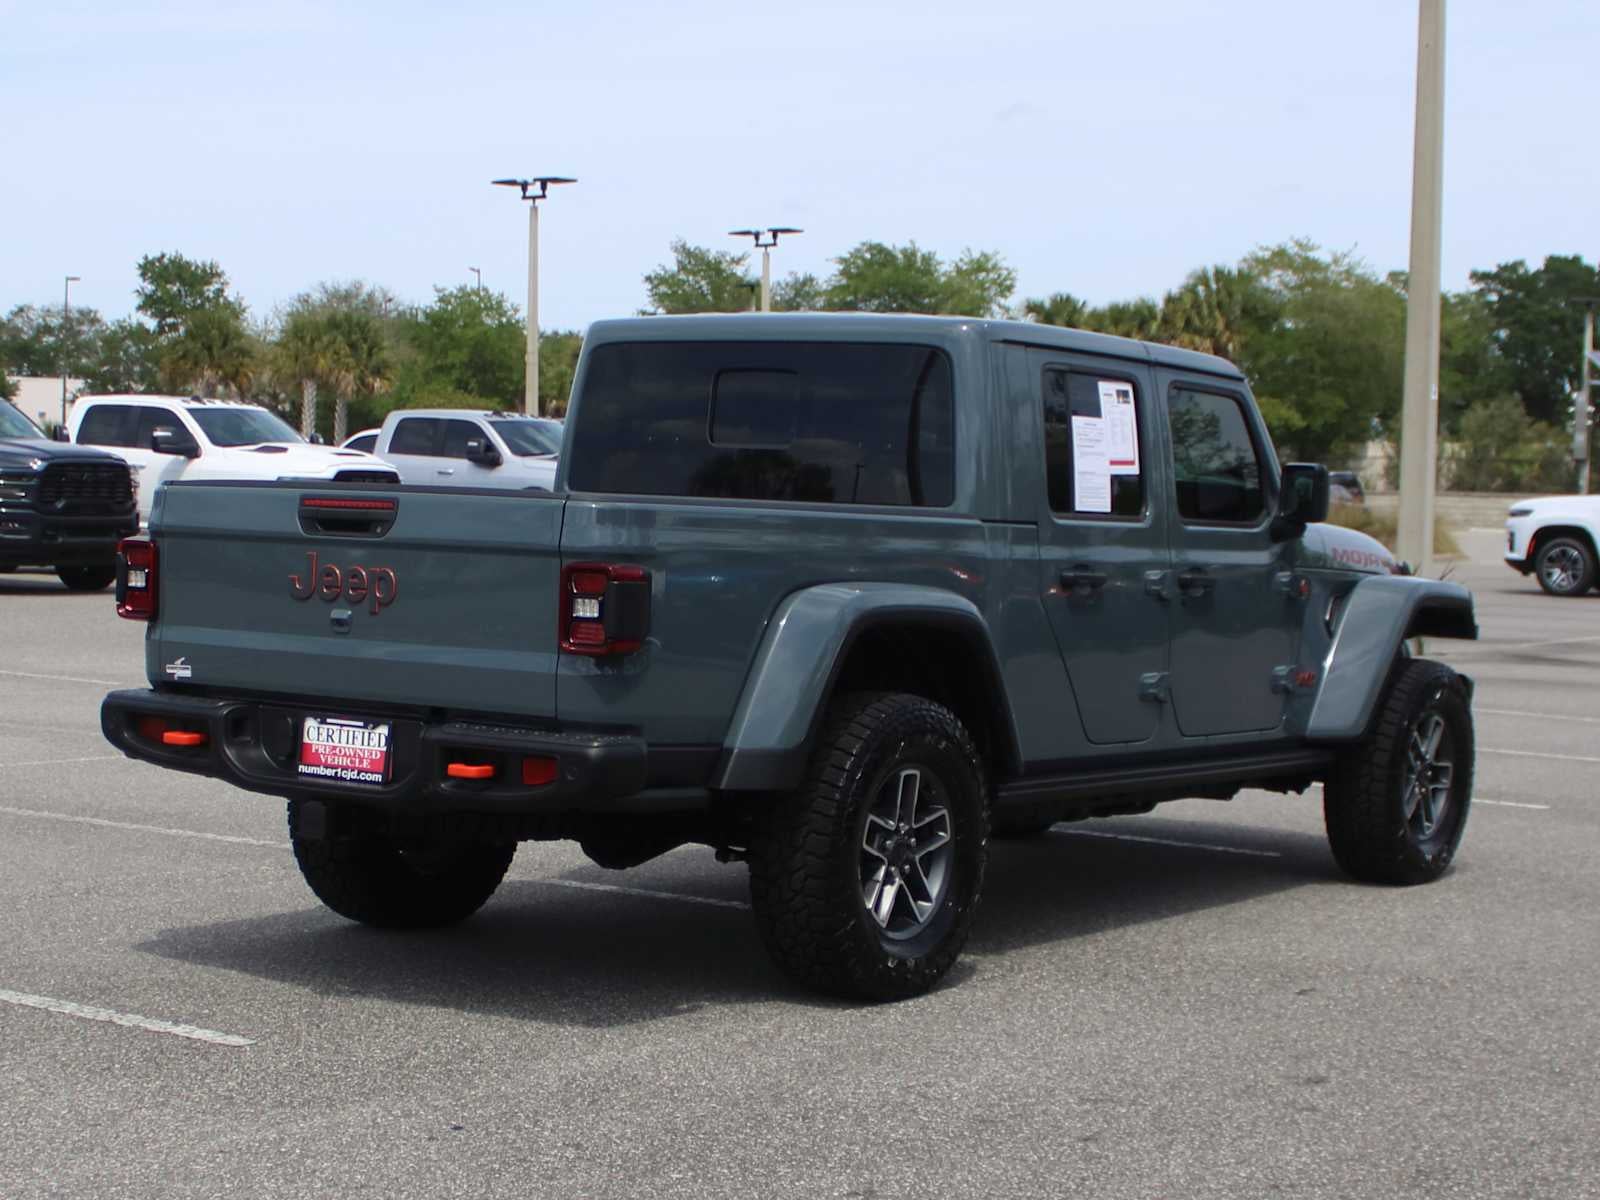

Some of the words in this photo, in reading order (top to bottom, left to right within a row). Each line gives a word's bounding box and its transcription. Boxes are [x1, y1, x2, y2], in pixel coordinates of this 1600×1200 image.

[288, 551, 397, 616] Jeep
[306, 725, 386, 748] CERTIFIED
[311, 744, 381, 760] PRE-OWNED
[320, 754, 371, 768] VEHICLE
[298, 764, 382, 782] number1cjd.com
